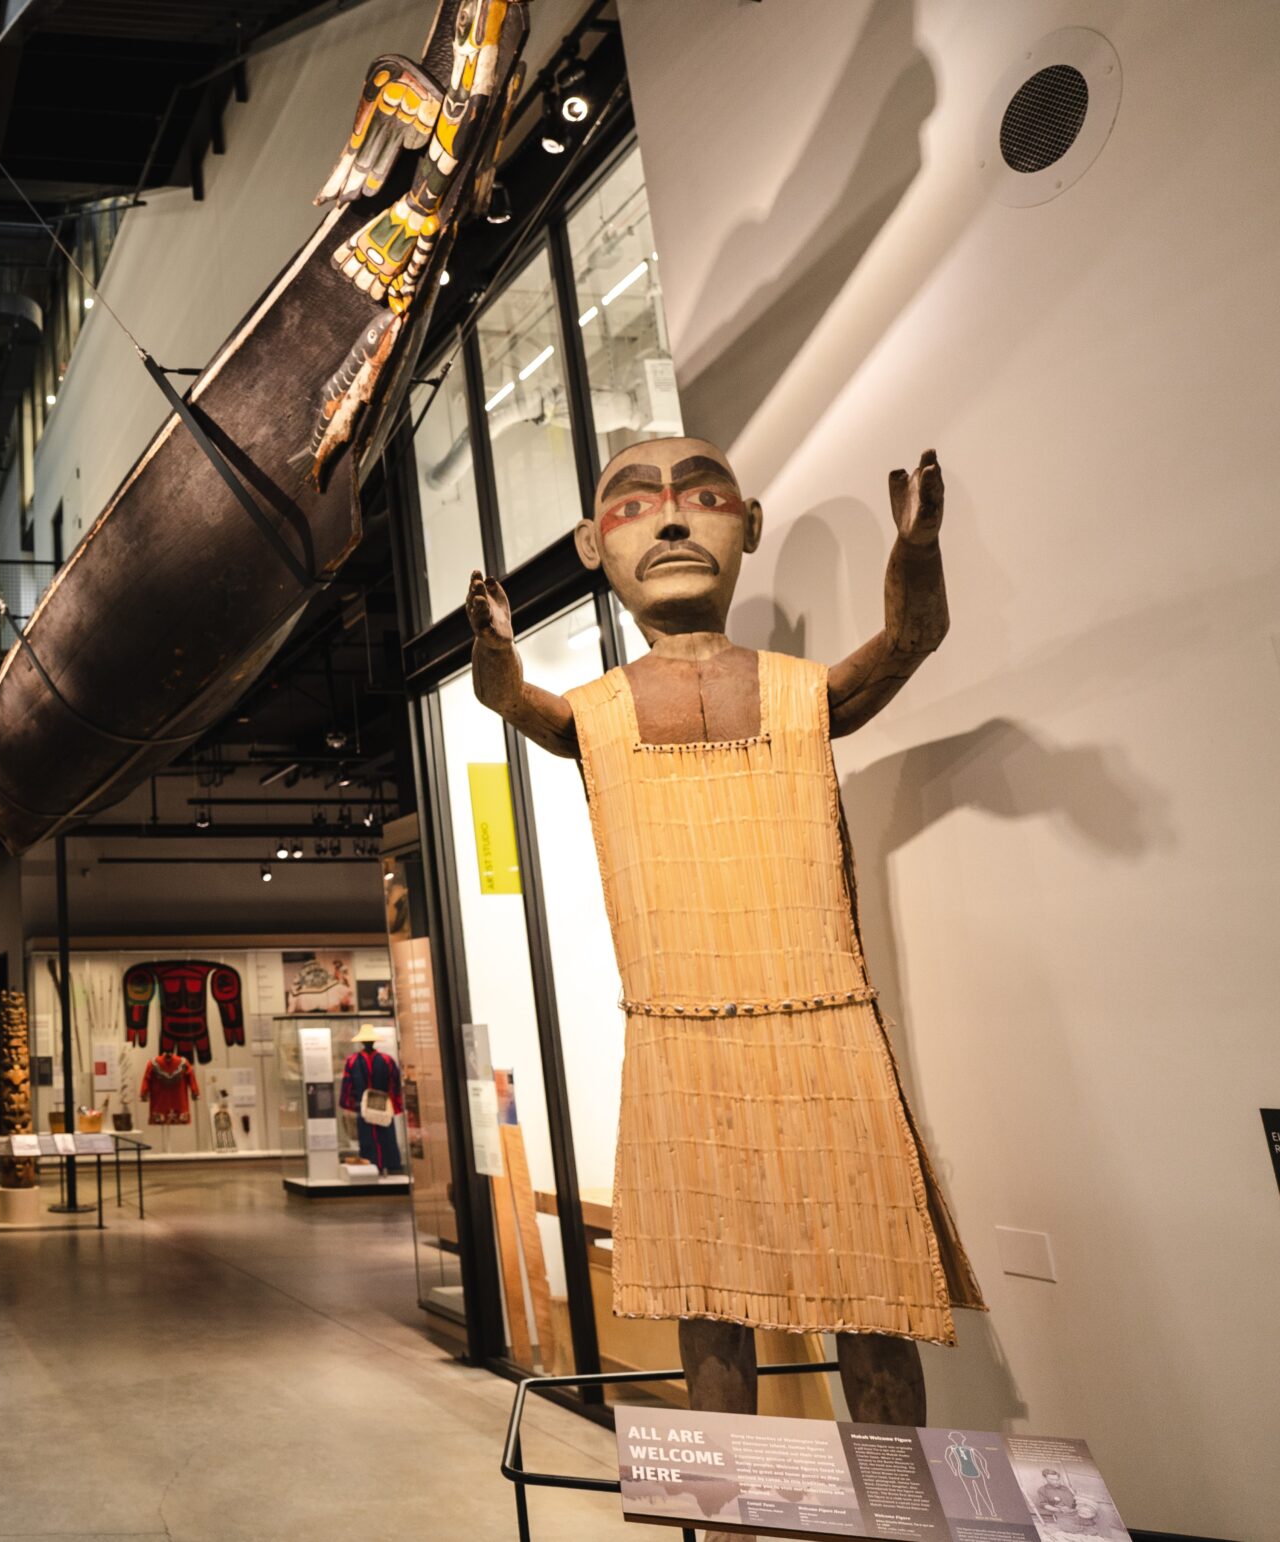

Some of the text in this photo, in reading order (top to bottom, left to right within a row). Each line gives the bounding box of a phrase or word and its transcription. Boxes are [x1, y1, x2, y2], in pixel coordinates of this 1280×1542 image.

[628, 1426, 705, 1444] ALL ARE
[629, 1445, 725, 1466] WELCOME
[631, 1465, 683, 1483] HERE
